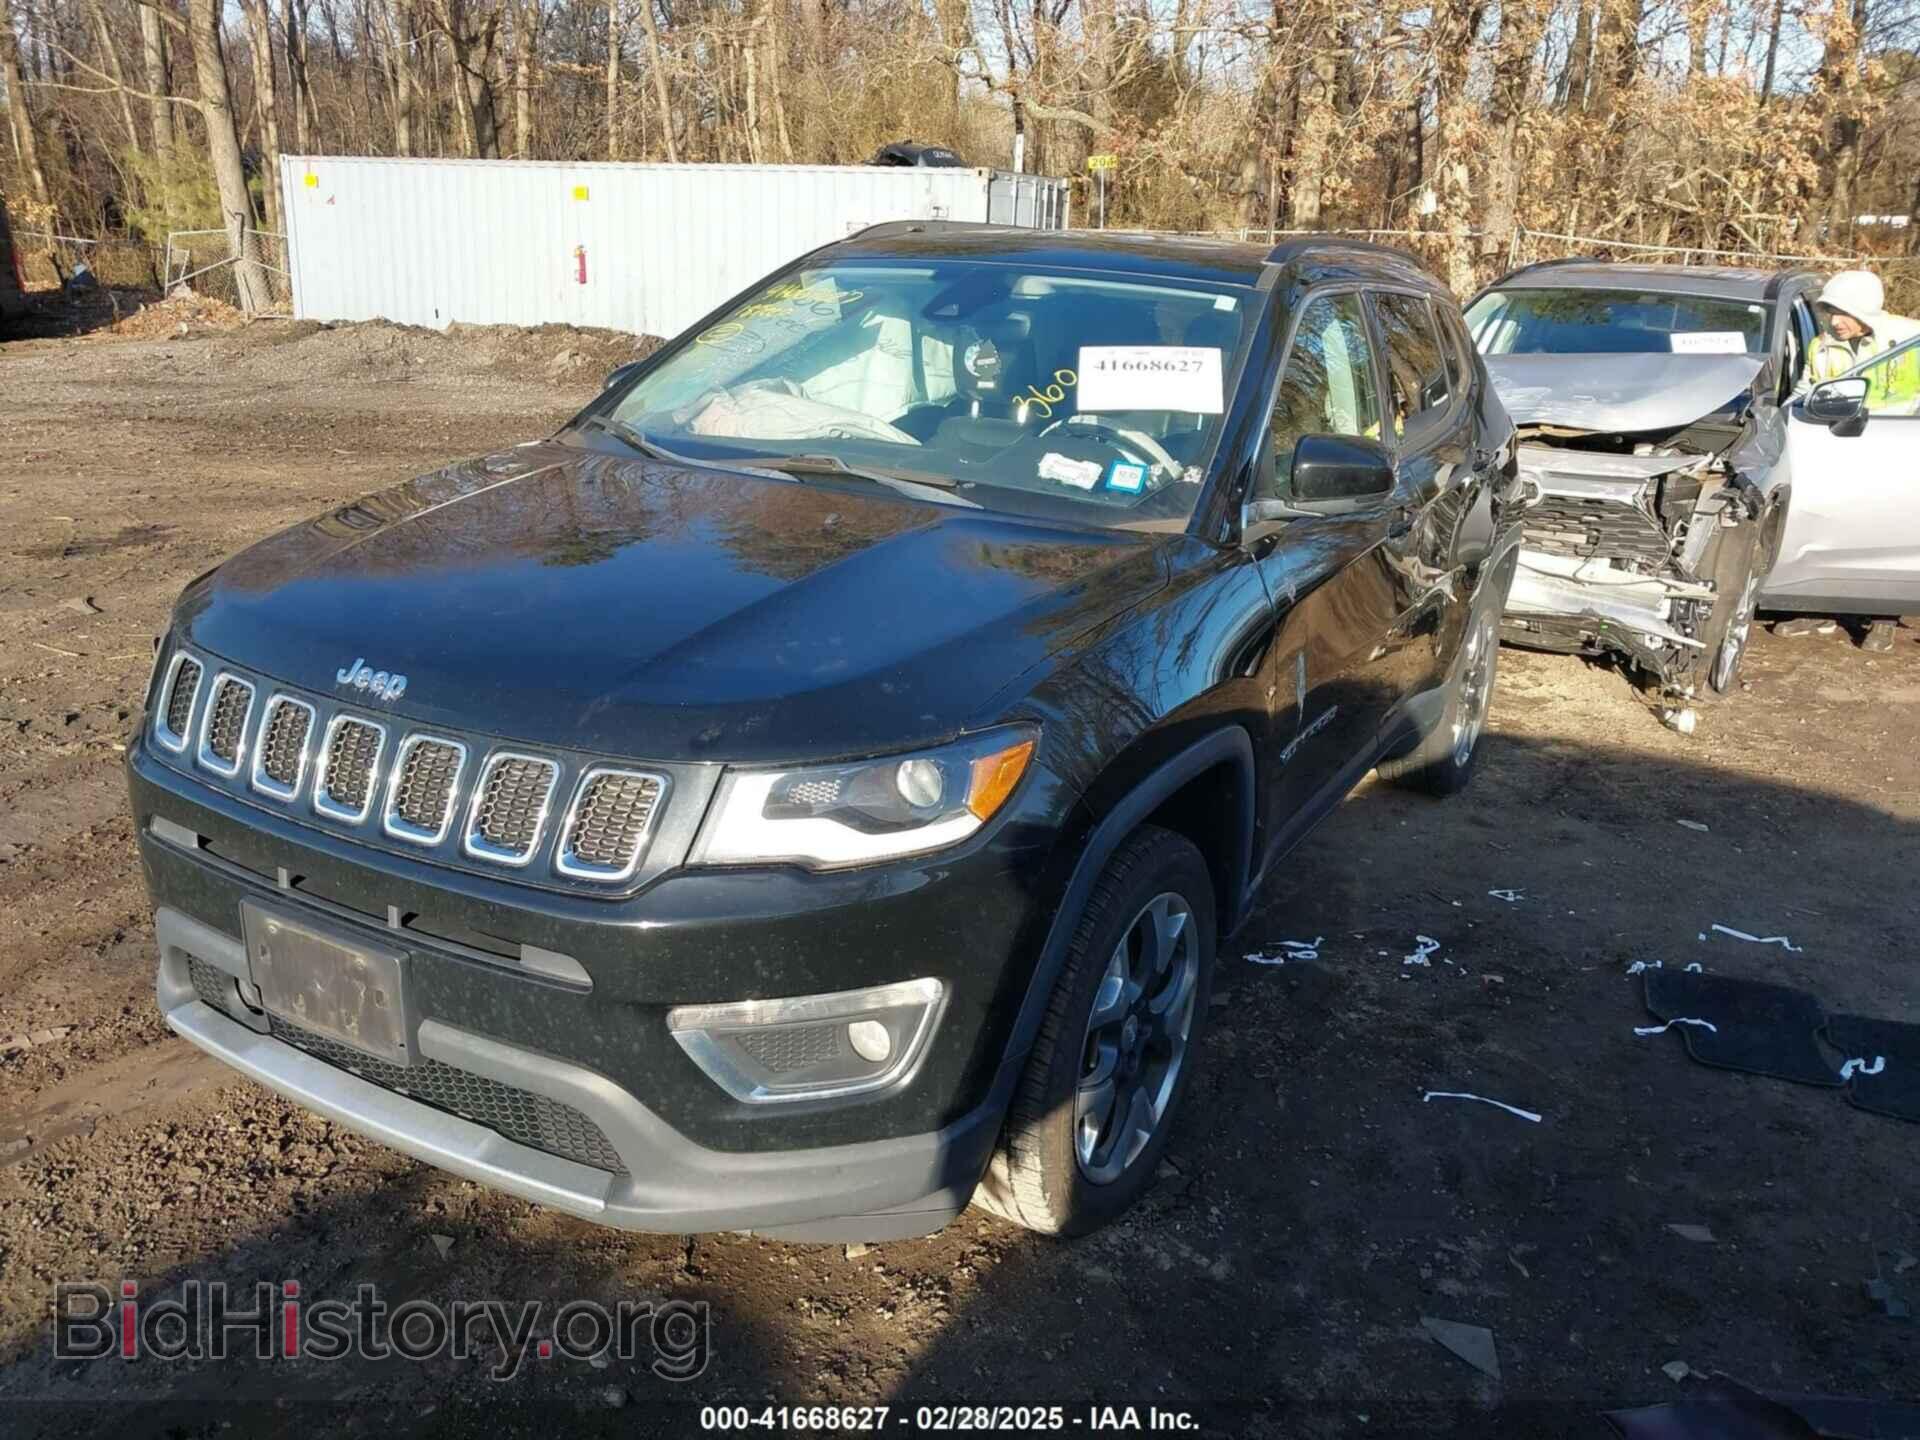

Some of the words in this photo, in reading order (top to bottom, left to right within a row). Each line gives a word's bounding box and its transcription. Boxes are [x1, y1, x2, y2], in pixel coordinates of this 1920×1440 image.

[1093, 359, 1203, 373] 41668627
[1012, 369, 1077, 418] 360
[336, 657, 408, 701] Jeep
